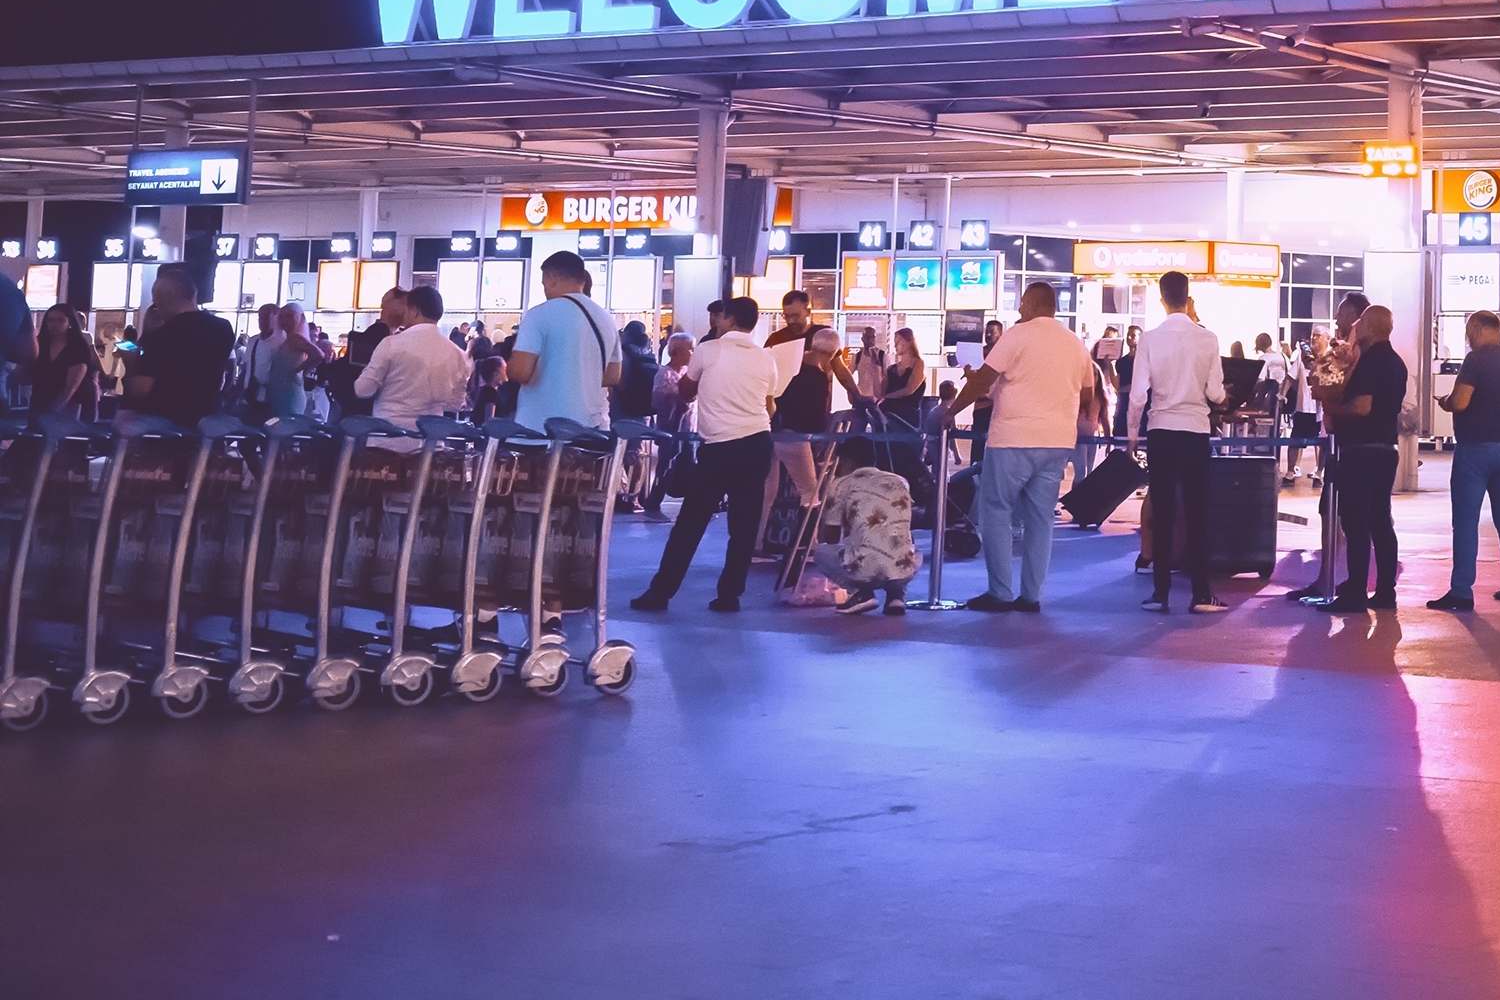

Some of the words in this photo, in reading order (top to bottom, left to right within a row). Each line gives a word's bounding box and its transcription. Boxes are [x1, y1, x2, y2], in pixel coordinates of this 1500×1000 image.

[1468, 178, 1493, 192] BURGER
[1469, 186, 1494, 199] KING
[562, 196, 658, 224] BURGER
[663, 195, 698, 221] KI
[858, 225, 882, 247] 41
[910, 225, 934, 247] 42
[960, 223, 986, 247] 43
[1459, 216, 1489, 241] 45
[215, 237, 236, 257] 37
